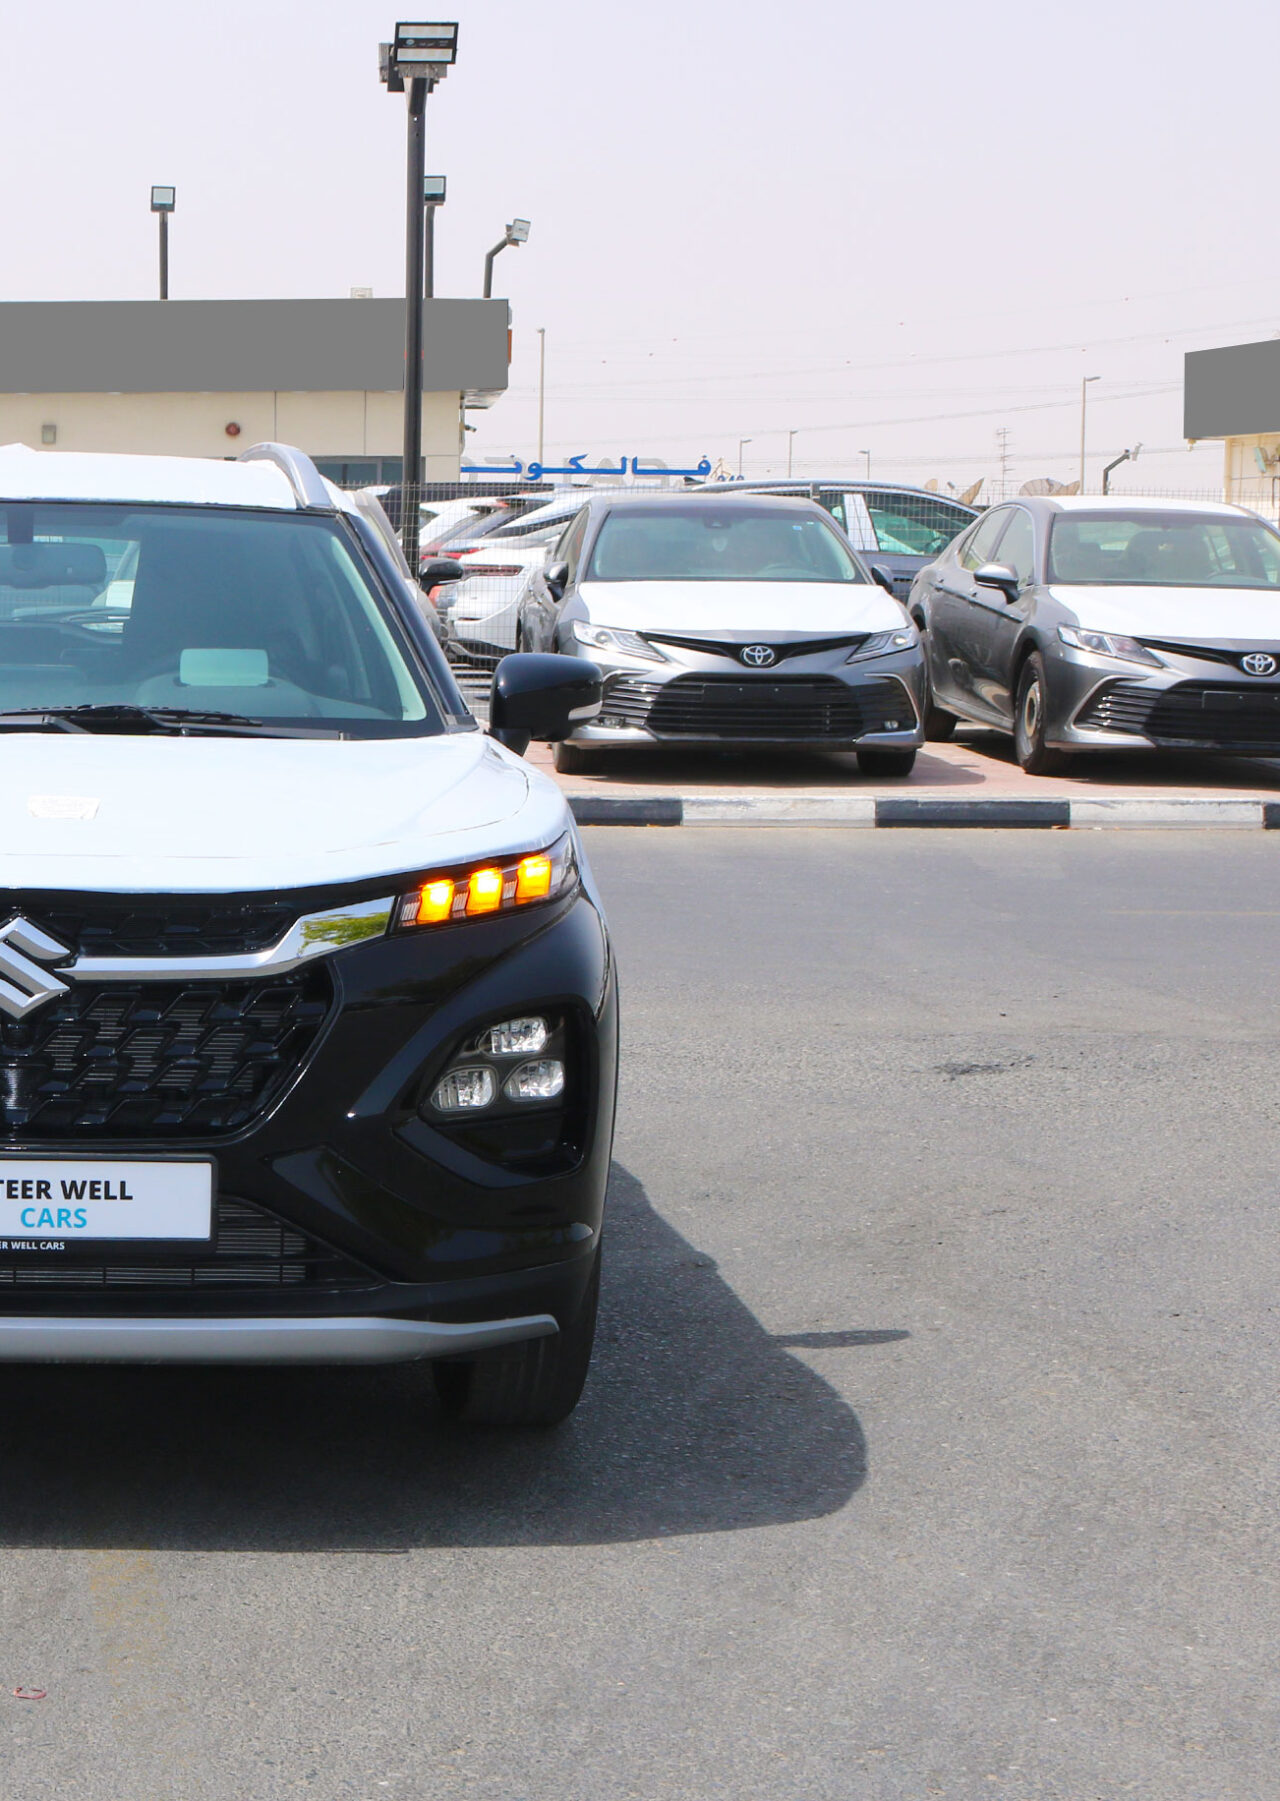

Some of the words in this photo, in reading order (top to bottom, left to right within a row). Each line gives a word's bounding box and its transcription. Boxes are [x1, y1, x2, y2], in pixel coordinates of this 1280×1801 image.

[61, 1180, 133, 1201] WELL
[20, 1207, 87, 1229] CARS
[11, 1241, 37, 1250] WELL
[39, 1241, 65, 1250] CARS
